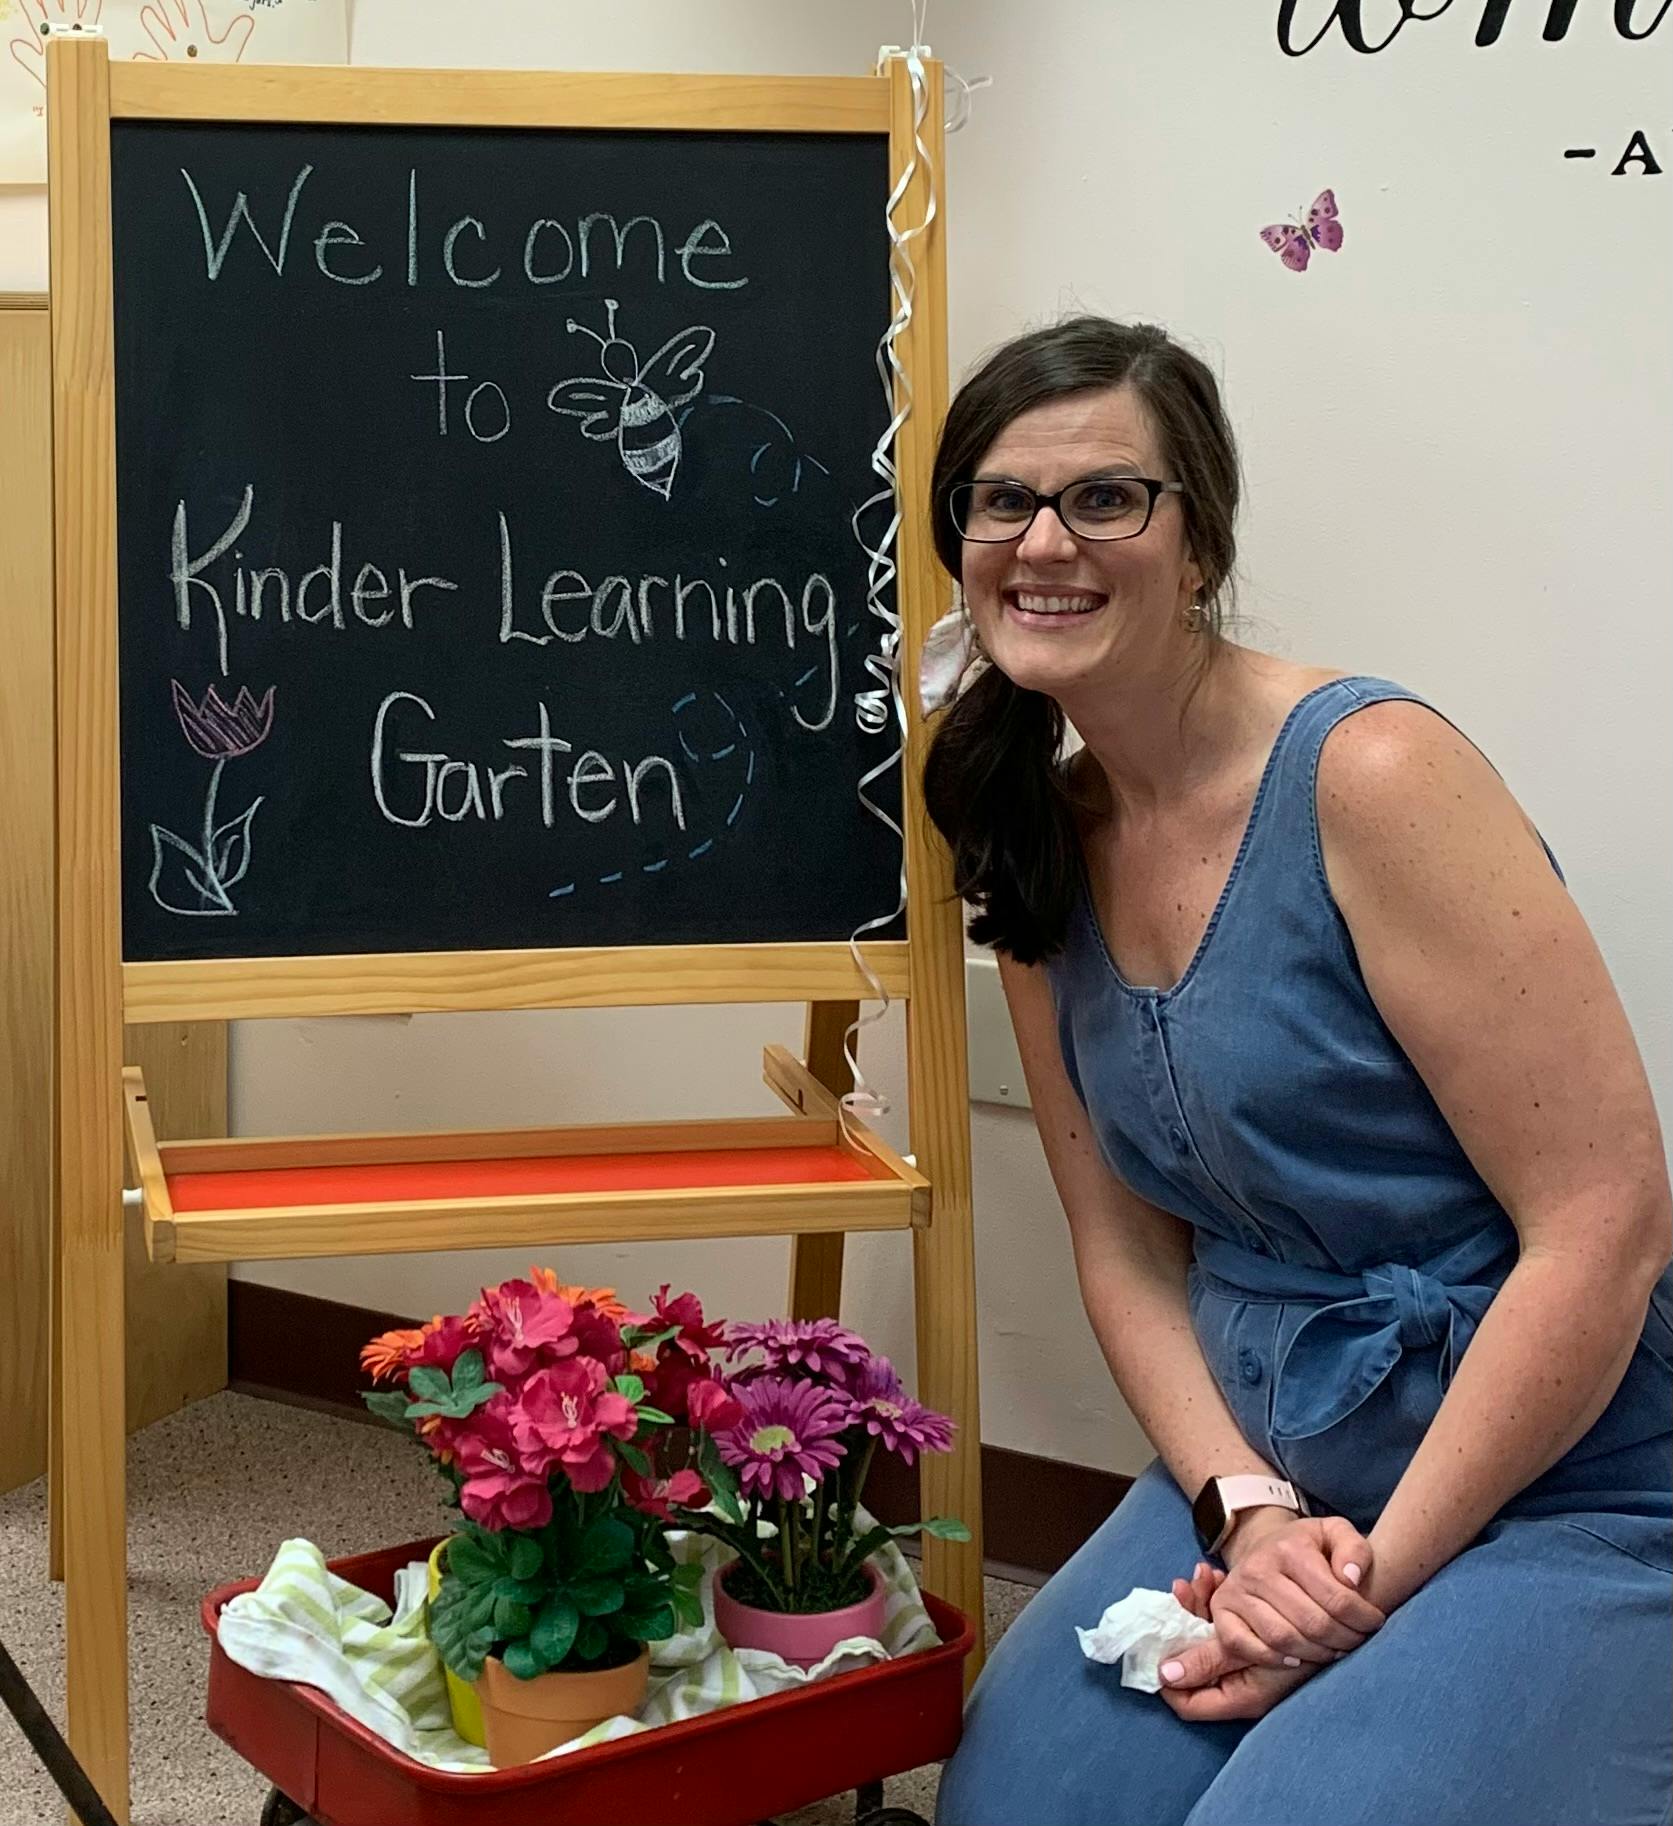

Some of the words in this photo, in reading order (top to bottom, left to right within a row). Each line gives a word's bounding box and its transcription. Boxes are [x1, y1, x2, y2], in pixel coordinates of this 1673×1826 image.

[180, 164, 749, 289] Welcome
[410, 330, 511, 443] to
[170, 483, 459, 677] Kinder
[499, 511, 838, 731] Learning
[370, 691, 687, 831] Garten
